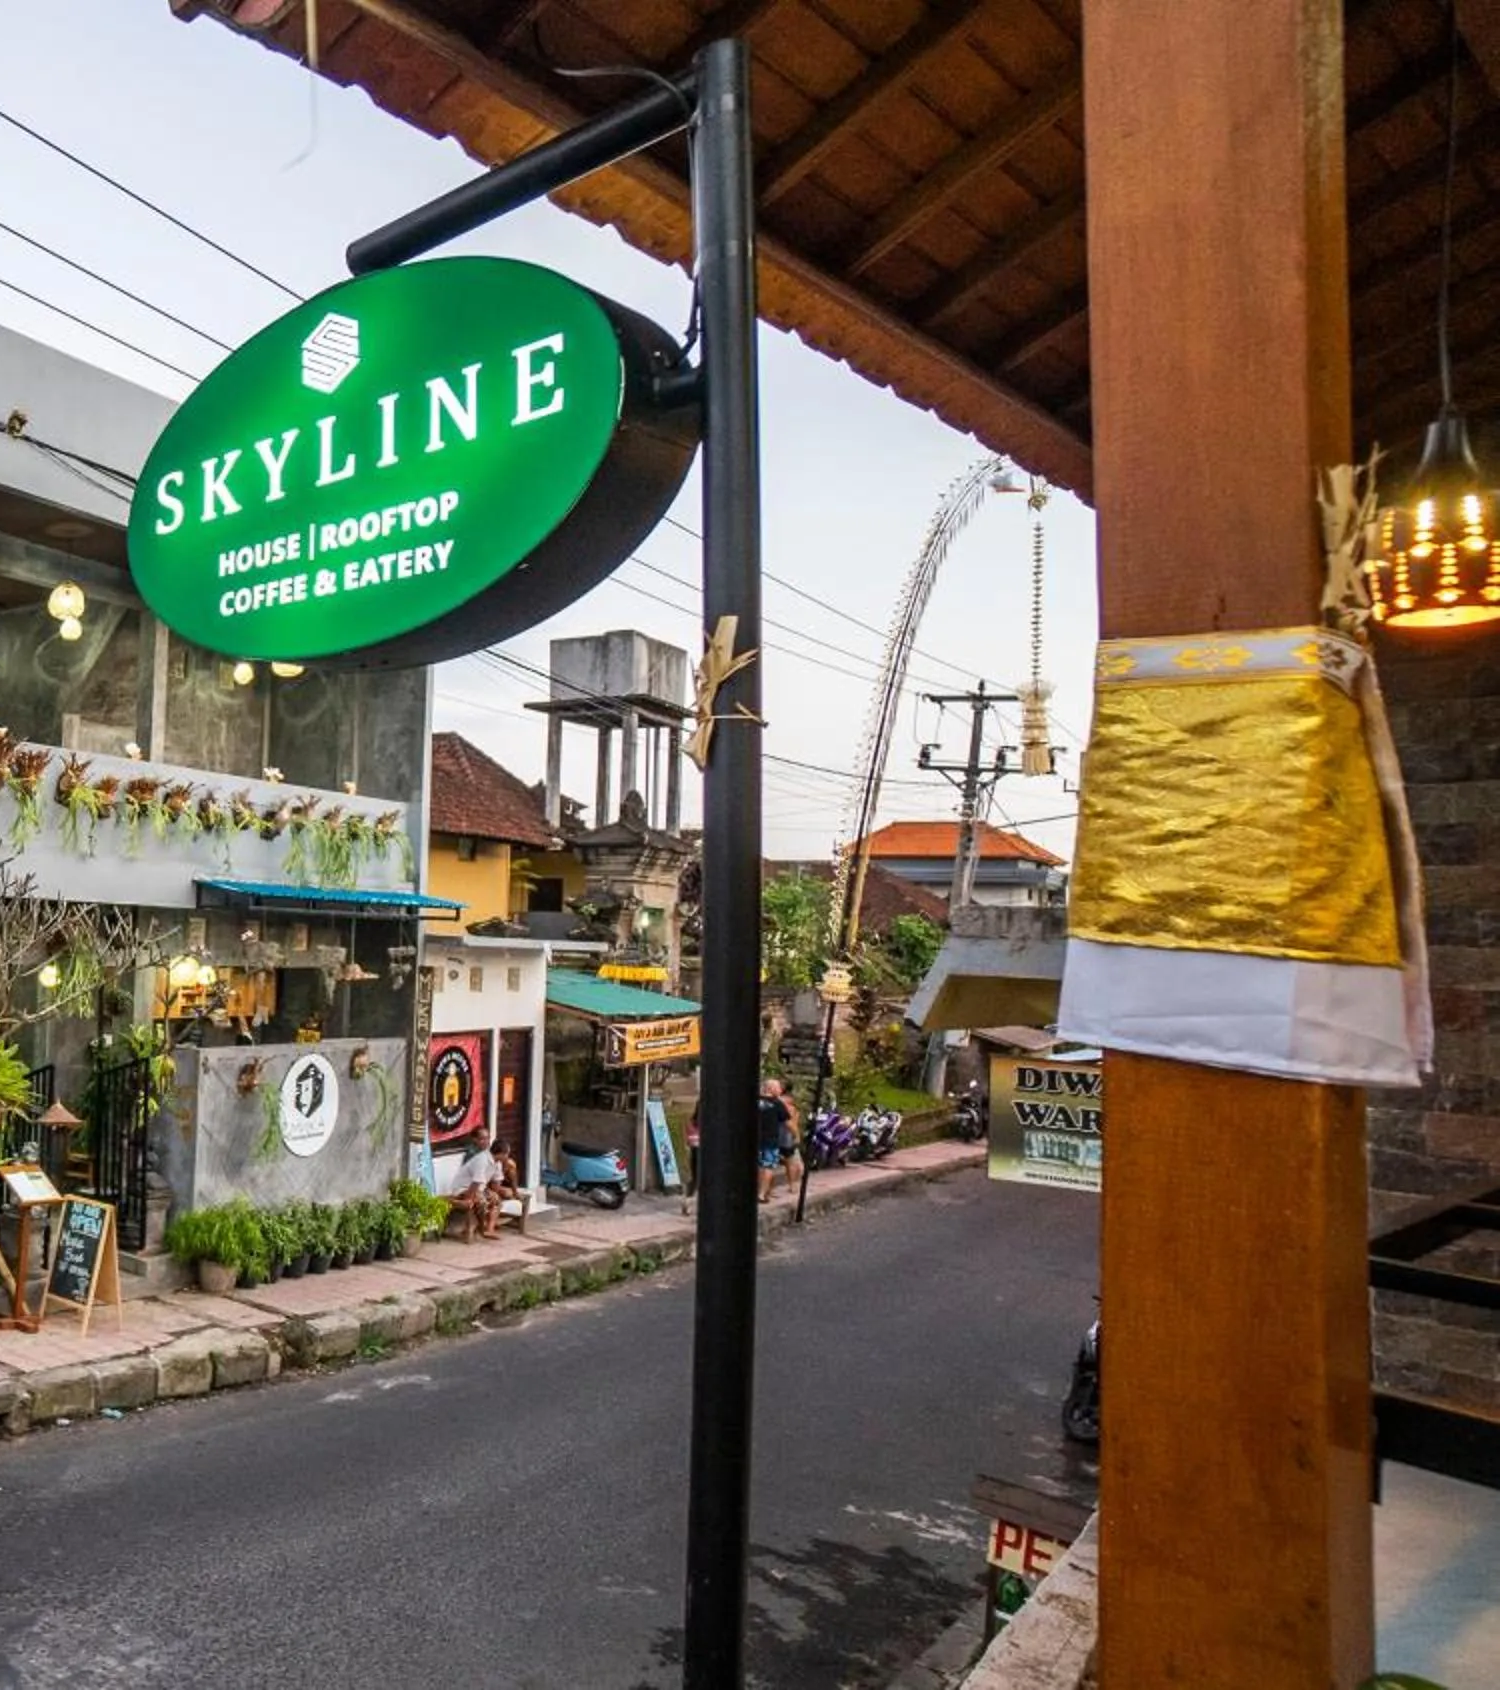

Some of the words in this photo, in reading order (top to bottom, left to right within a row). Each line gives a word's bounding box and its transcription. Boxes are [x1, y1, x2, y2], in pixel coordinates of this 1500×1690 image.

[154, 333, 565, 535] SKYLINE
[218, 537, 302, 577] HOUSE
[320, 491, 460, 552] ROOFTOP
[218, 573, 308, 617] COFFEE
[313, 571, 337, 598] &
[343, 540, 455, 590] EATERY
[1015, 1067, 1102, 1096] DIW
[994, 1519, 1071, 1576] PE
